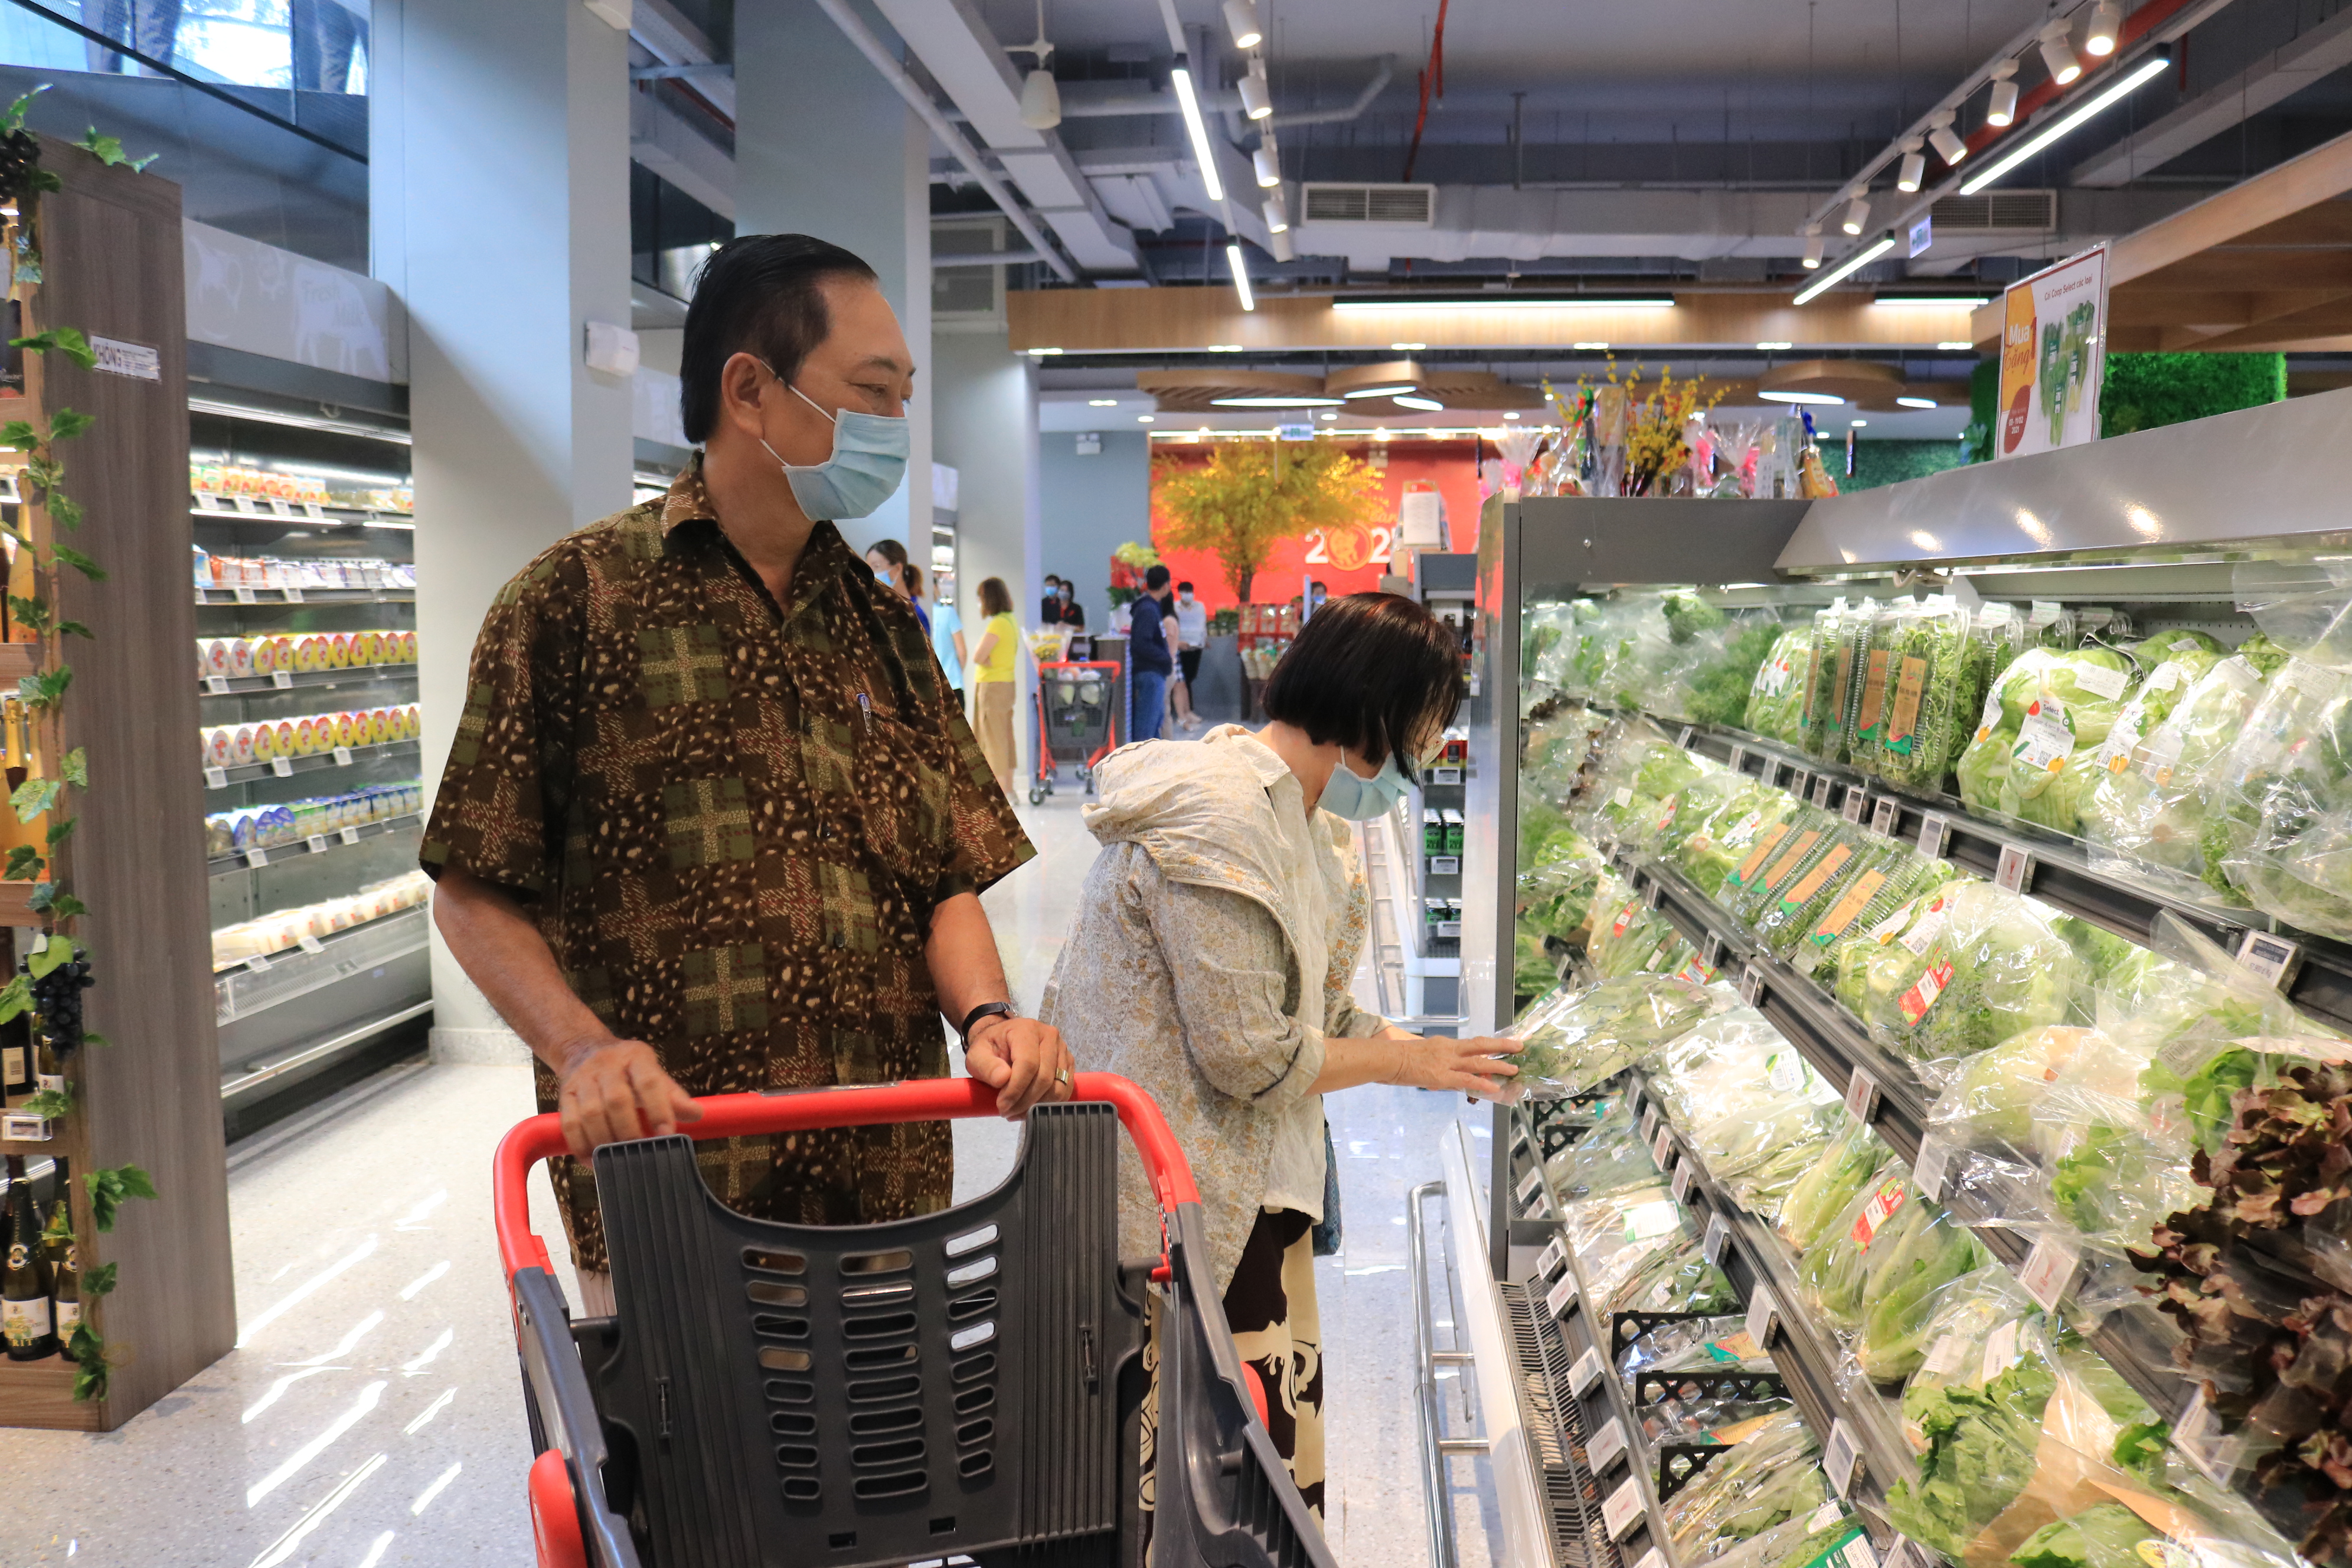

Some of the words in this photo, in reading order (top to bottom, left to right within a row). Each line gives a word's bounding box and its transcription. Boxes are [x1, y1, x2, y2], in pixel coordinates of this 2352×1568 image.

[2052, 289, 2062, 298] Coop
[2063, 281, 2076, 293] Select
[2009, 324, 2029, 345] Mua
[2043, 704, 2059, 716] Select
